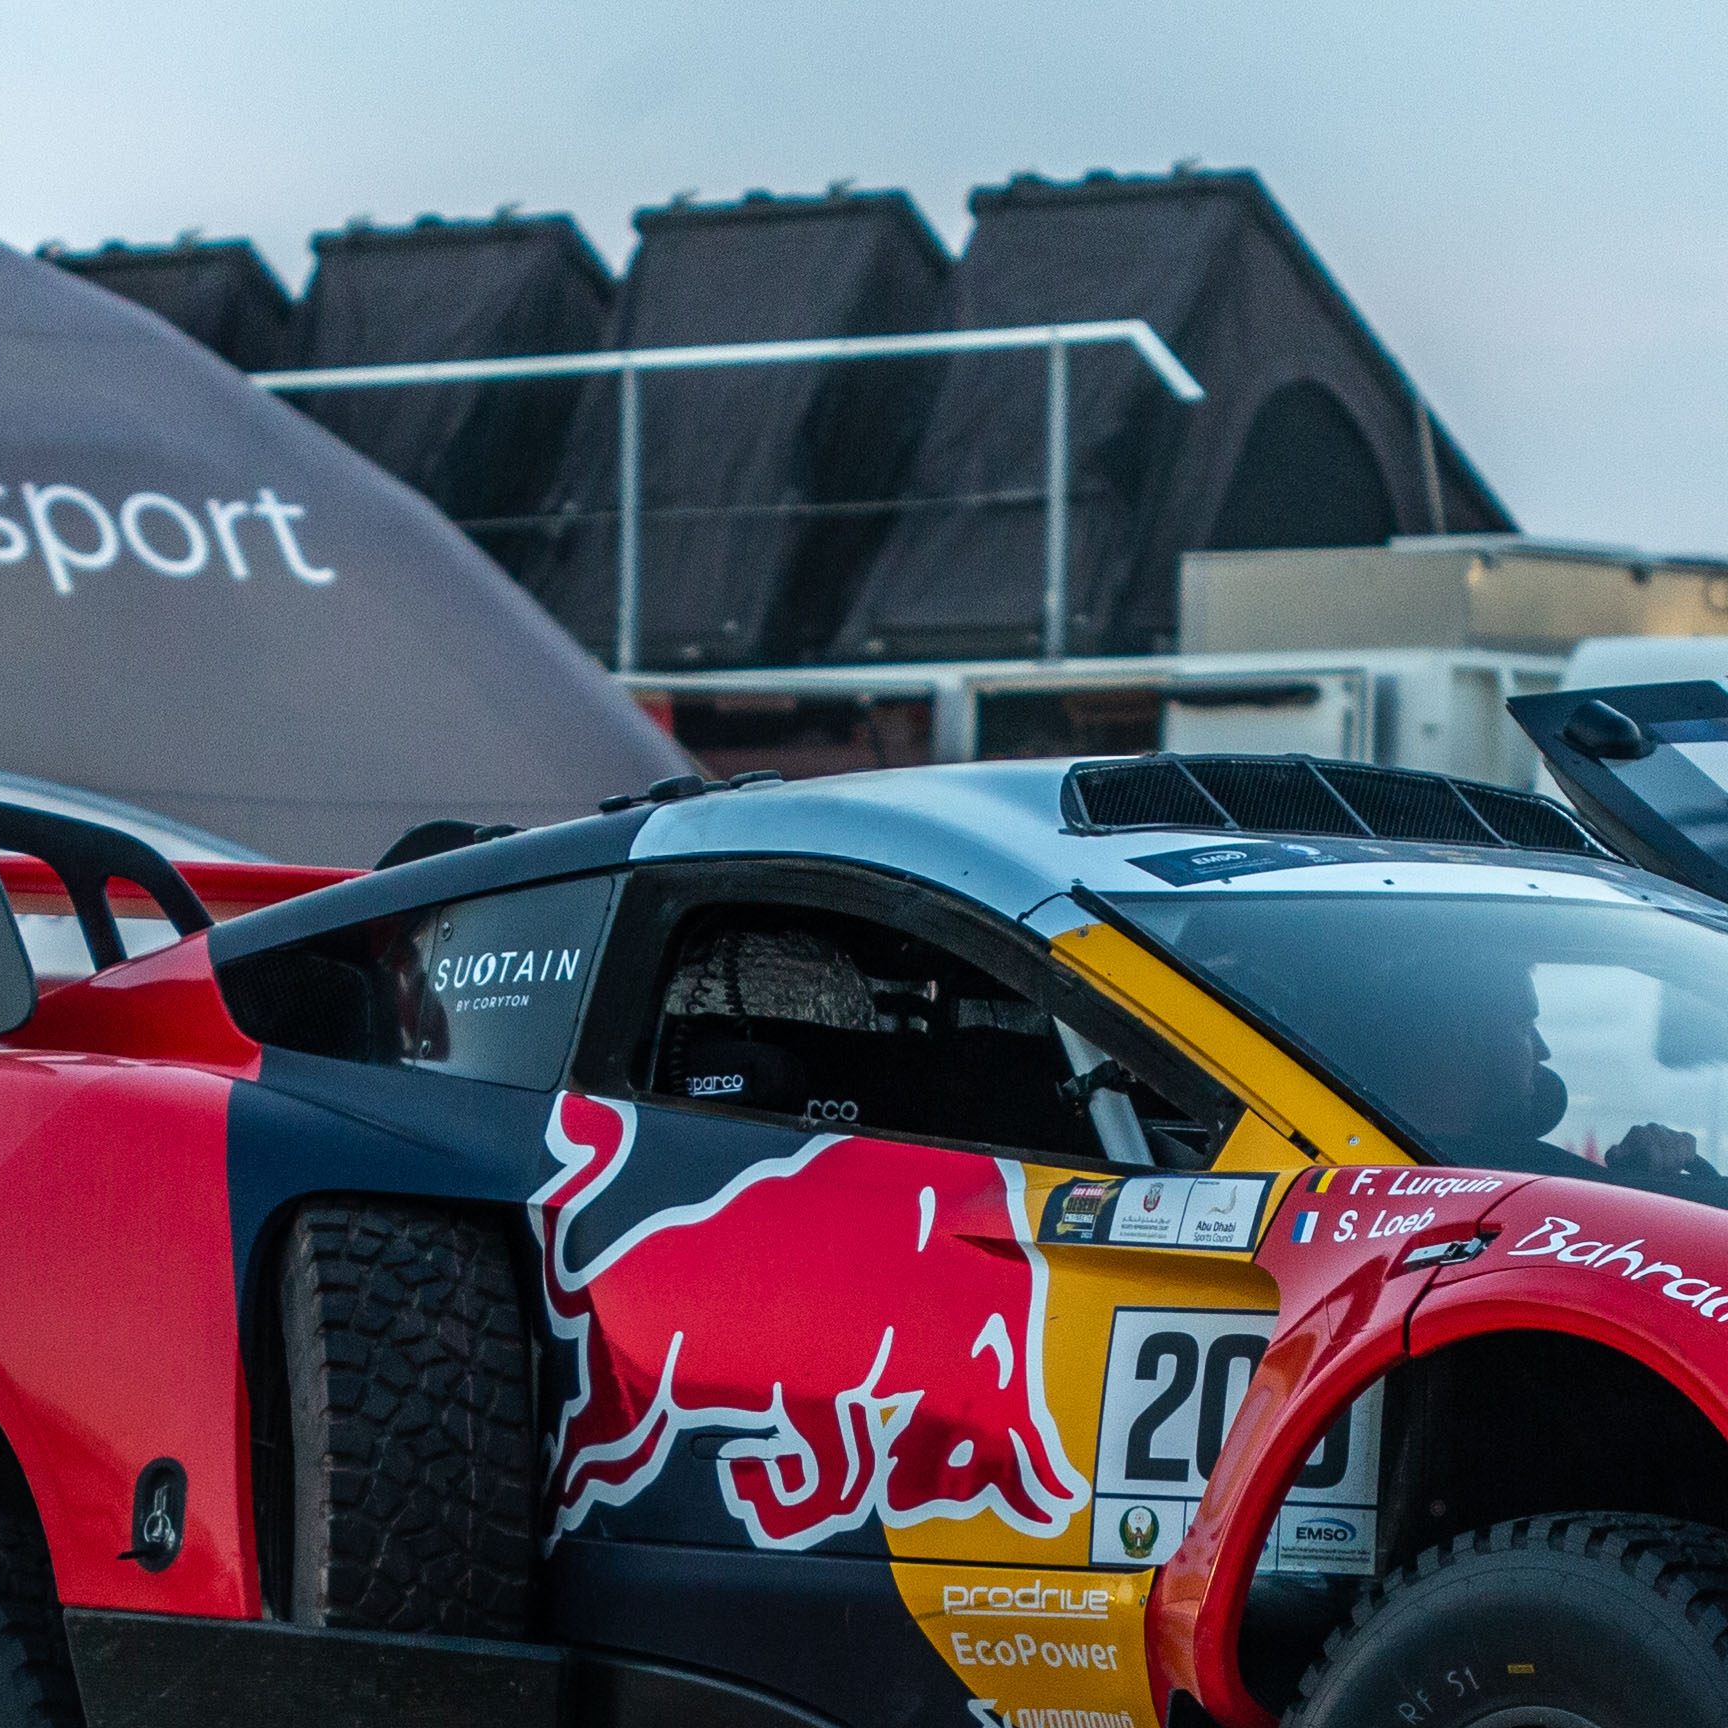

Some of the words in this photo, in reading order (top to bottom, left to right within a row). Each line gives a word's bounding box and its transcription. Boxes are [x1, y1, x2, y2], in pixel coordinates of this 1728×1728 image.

[456, 999, 471, 1012] BY
[473, 995, 530, 1010] CORYTON
[1349, 1169, 1375, 1195] F.
[1388, 1170, 1503, 1198] Lurquin
[1196, 1220, 1212, 1231] Abu
[1213, 1221, 1236, 1232] Dhabi
[1334, 1209, 1357, 1243] S.
[1368, 1207, 1436, 1239] Loeb
[1296, 1526, 1348, 1542] EMSO
[943, 1580, 1109, 1614] prodrive
